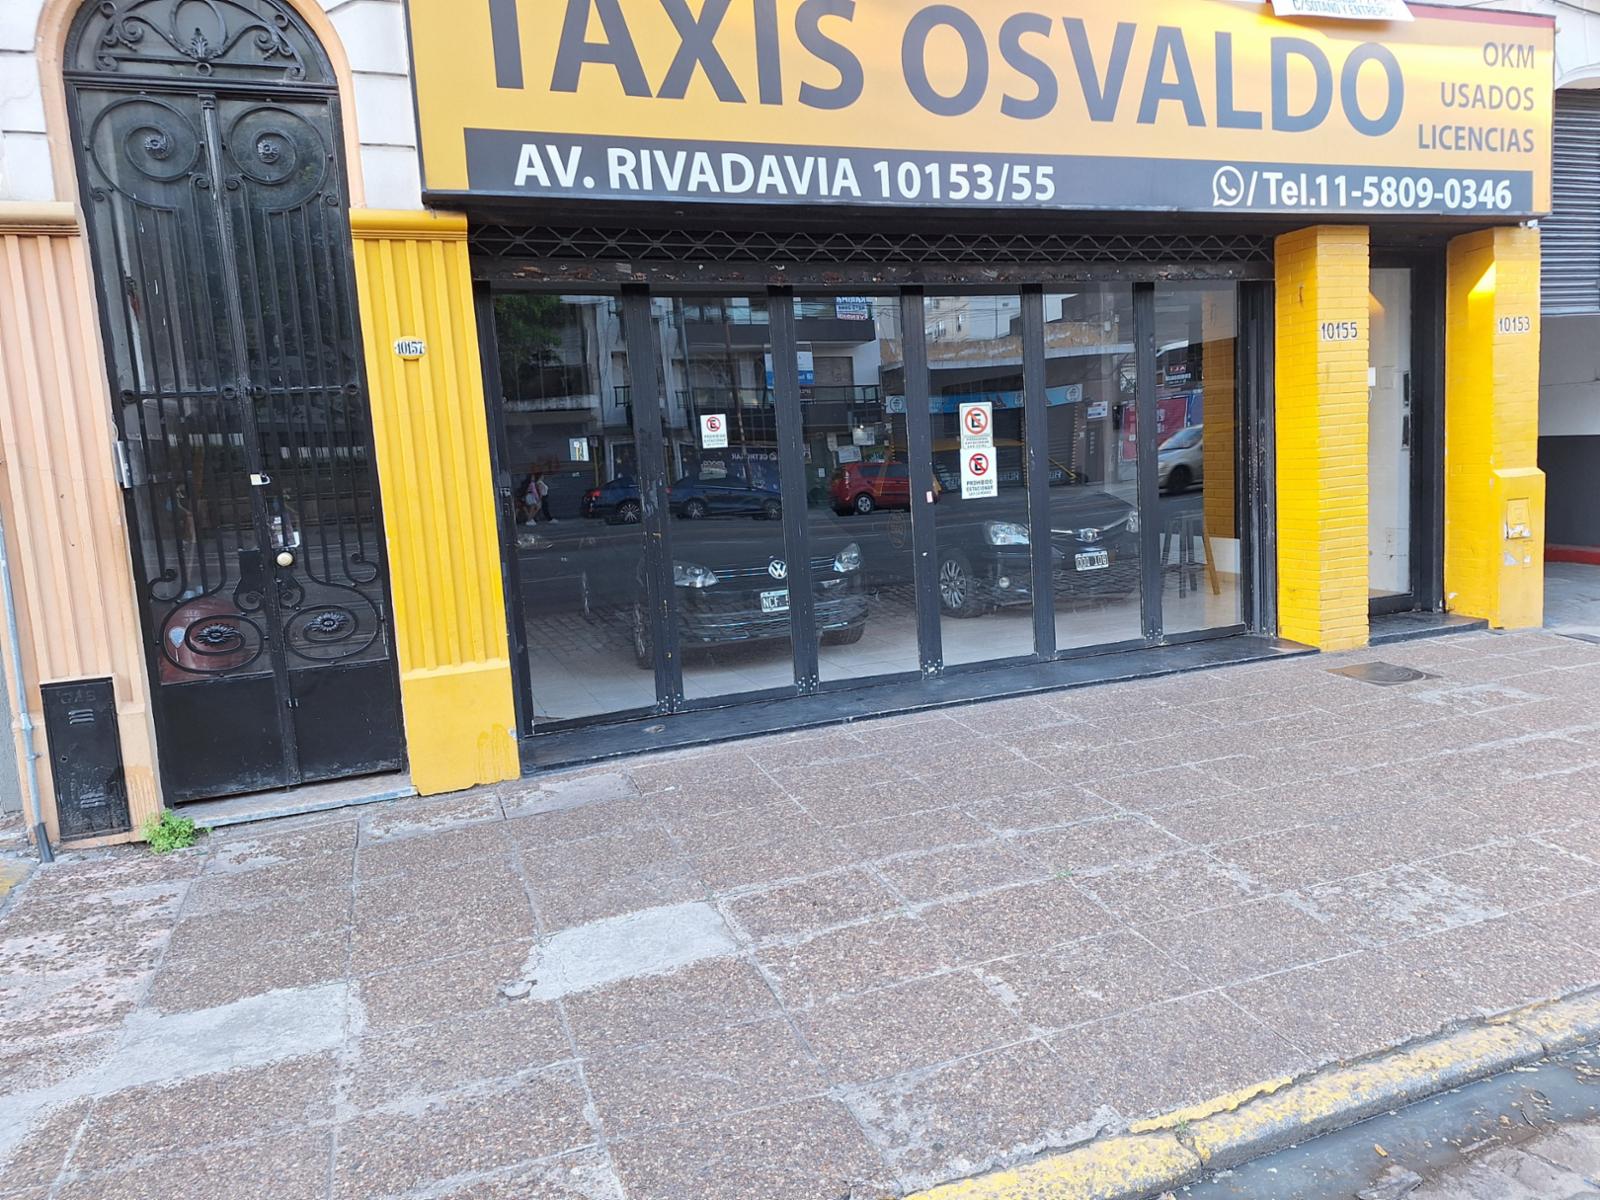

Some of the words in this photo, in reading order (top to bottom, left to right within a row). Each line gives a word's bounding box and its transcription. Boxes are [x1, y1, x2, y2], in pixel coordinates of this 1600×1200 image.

[901, 5, 1405, 137] OSVALDO
[1441, 82, 1534, 111] USADOS
[1418, 124, 1534, 153] LICENCIAS
[514, 143, 595, 189] AV.
[607, 146, 862, 198] RIVADAVIA
[873, 160, 1056, 204] 10153/55
[1321, 321, 1358, 339] 10155
[1499, 316, 1530, 331] 10153
[397, 341, 423, 354] 10157
